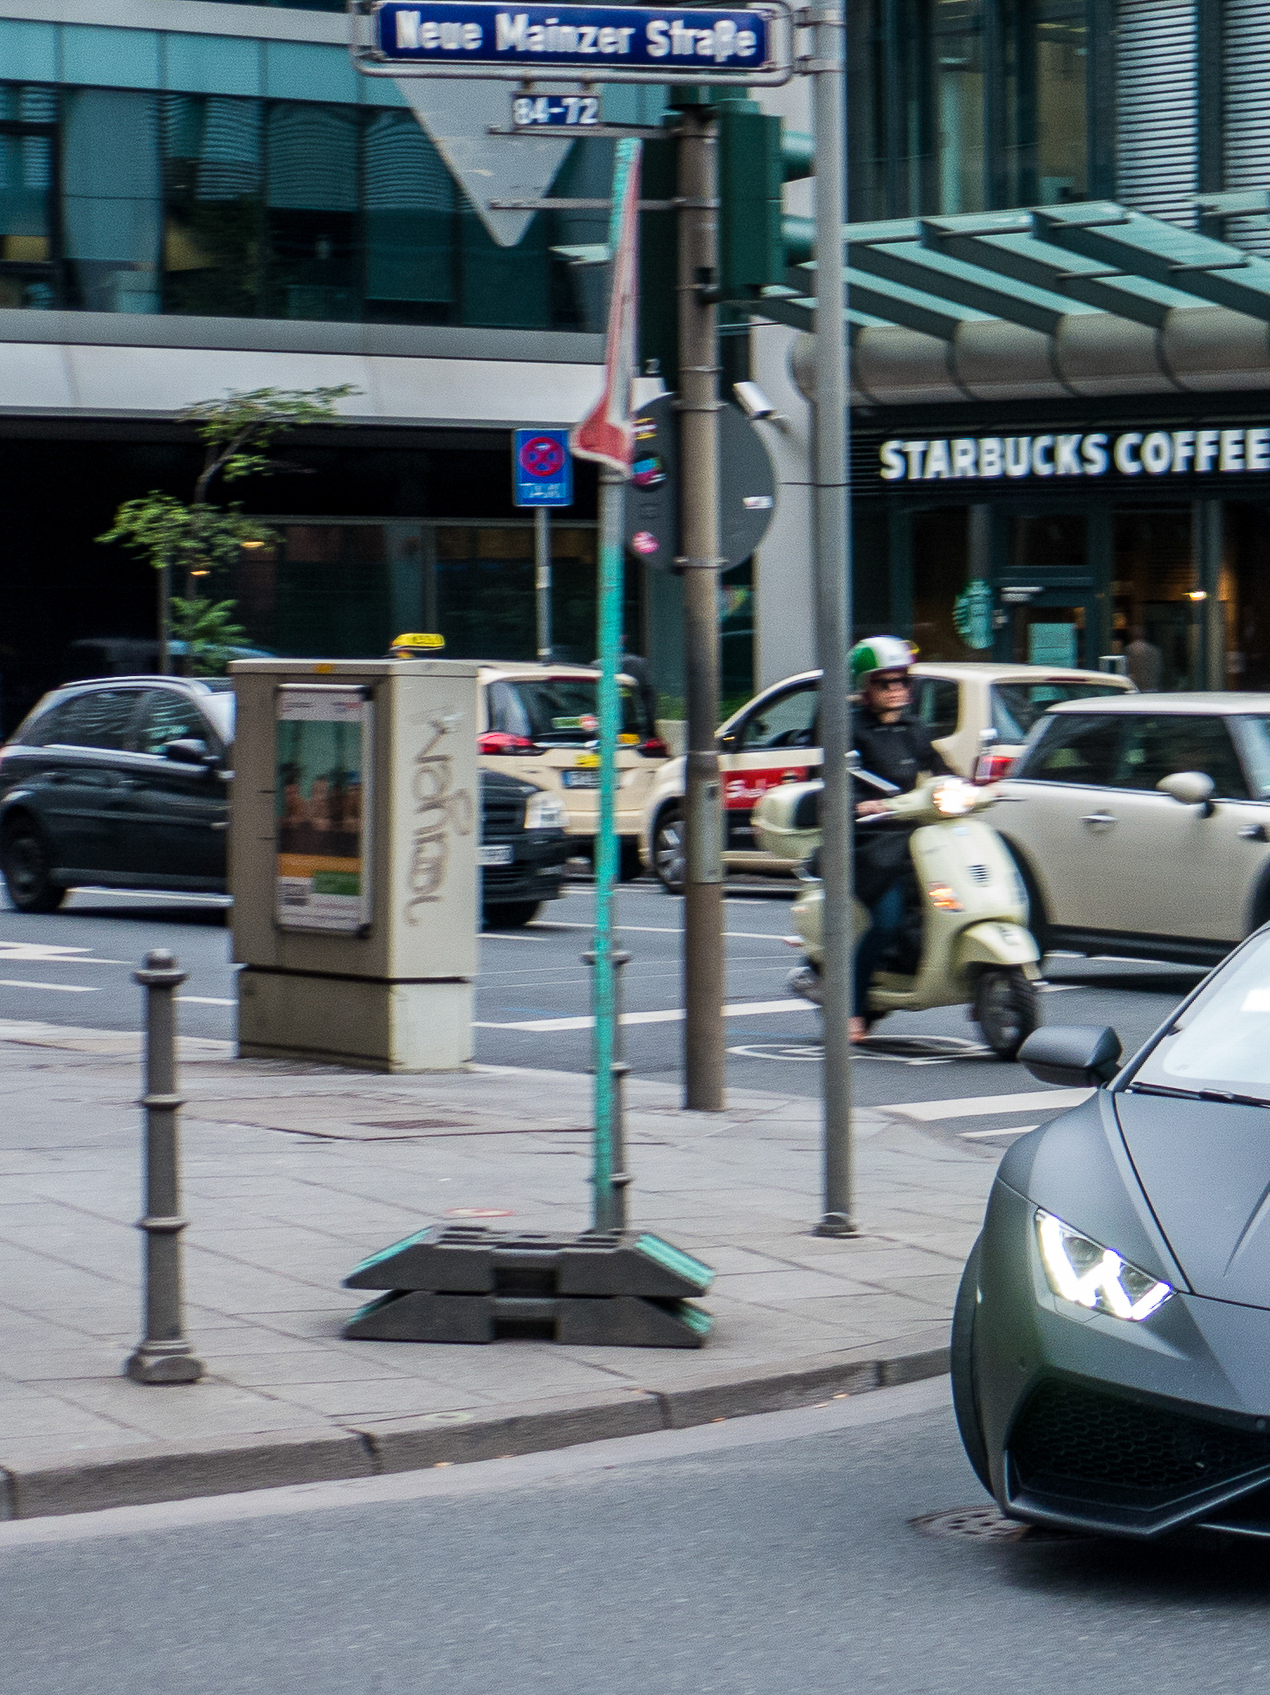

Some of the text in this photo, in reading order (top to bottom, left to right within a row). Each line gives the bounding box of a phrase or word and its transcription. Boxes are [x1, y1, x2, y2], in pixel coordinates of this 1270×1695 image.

[396, 10, 757, 62] Neue Mainzer Straße
[880, 433, 1108, 480] STARBUCKS
